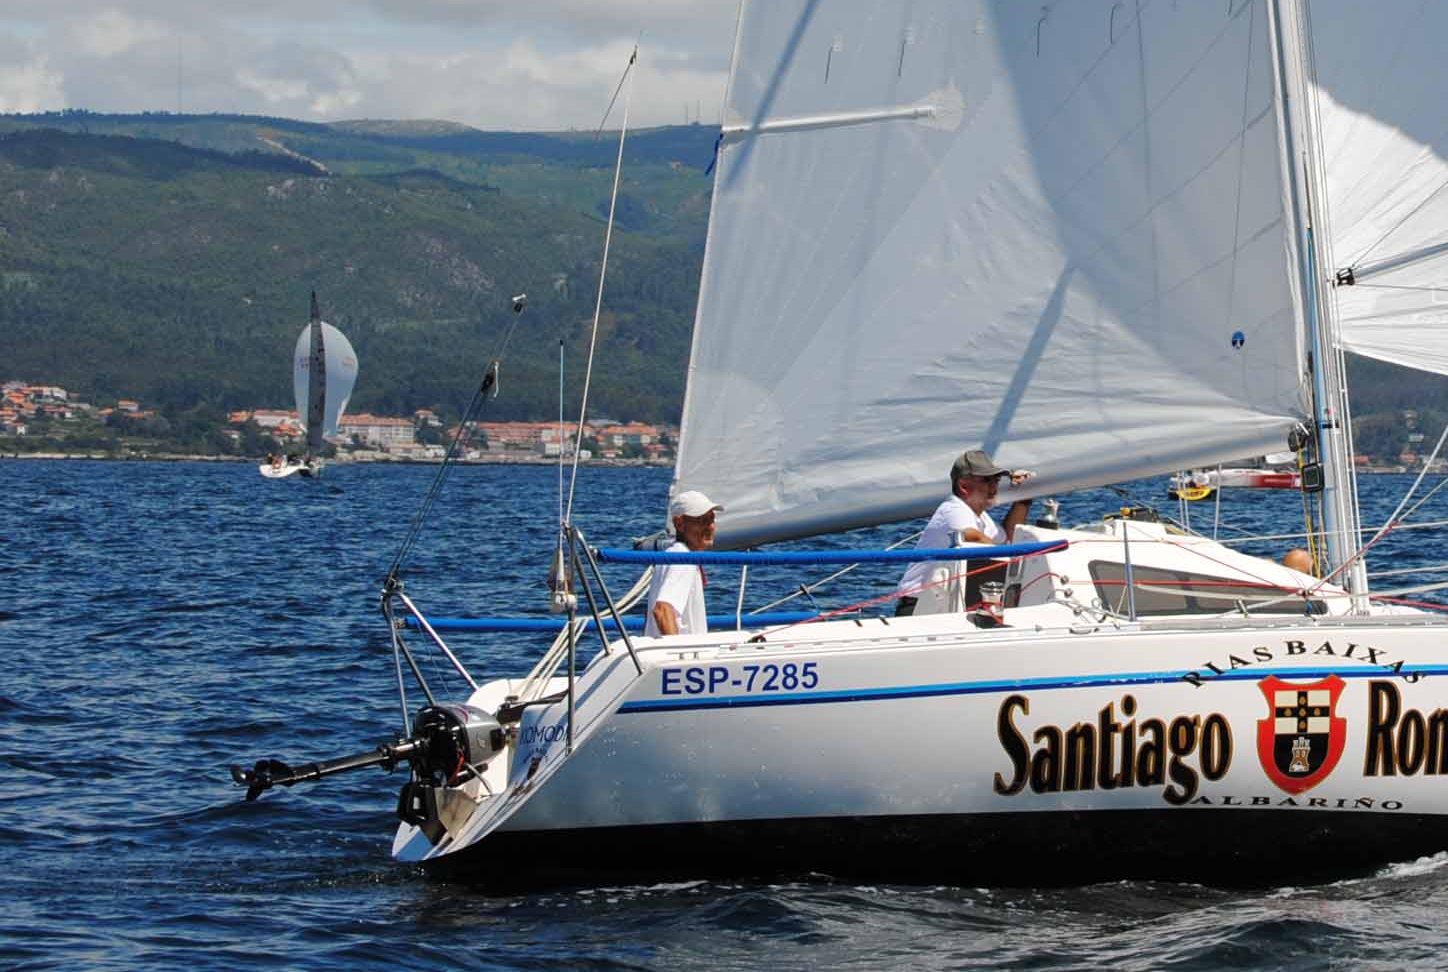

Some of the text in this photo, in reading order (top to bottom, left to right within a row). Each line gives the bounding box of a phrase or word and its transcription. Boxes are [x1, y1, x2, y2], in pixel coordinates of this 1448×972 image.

[661, 662, 819, 695] ESP-7285
[1181, 640, 1427, 688] RIAS BAIXAS
[993, 693, 1234, 806] Santiago
[1189, 794, 1405, 811] ALBARIÑO
